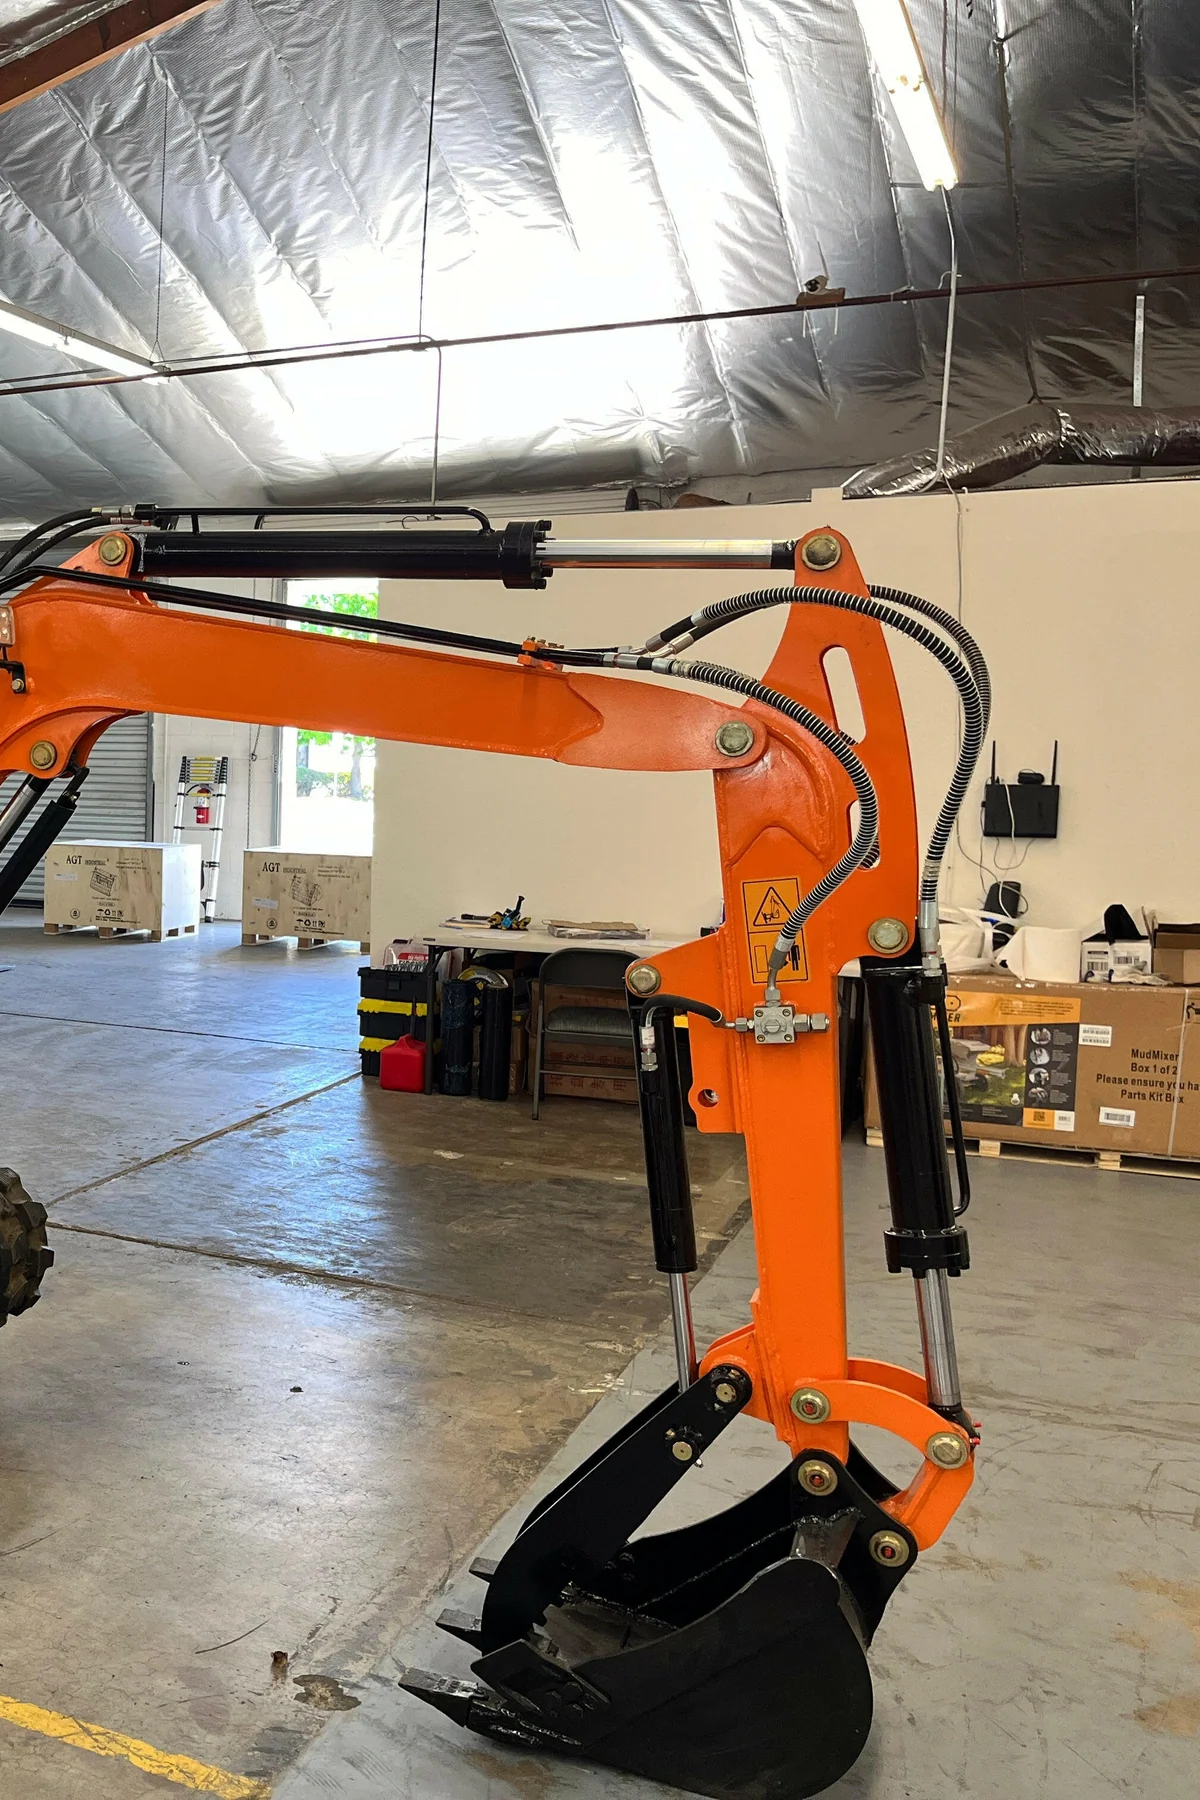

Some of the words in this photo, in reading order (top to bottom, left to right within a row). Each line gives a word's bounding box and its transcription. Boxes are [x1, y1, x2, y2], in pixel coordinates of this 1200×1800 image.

[66, 855, 83, 865] AGT
[262, 861, 281, 873] AGT
[1131, 1048, 1179, 1061] MudMixer
[1131, 1062, 1149, 1073] Box
[1153, 1064, 1157, 1073] 1
[1160, 1065, 1170, 1074] of
[1172, 1066, 1177, 1075] 2
[1096, 1073, 1128, 1085] Please
[1131, 1078, 1164, 1088] ensure
[1121, 1089, 1146, 1100] Parts
[1149, 1092, 1163, 1102] Kit
